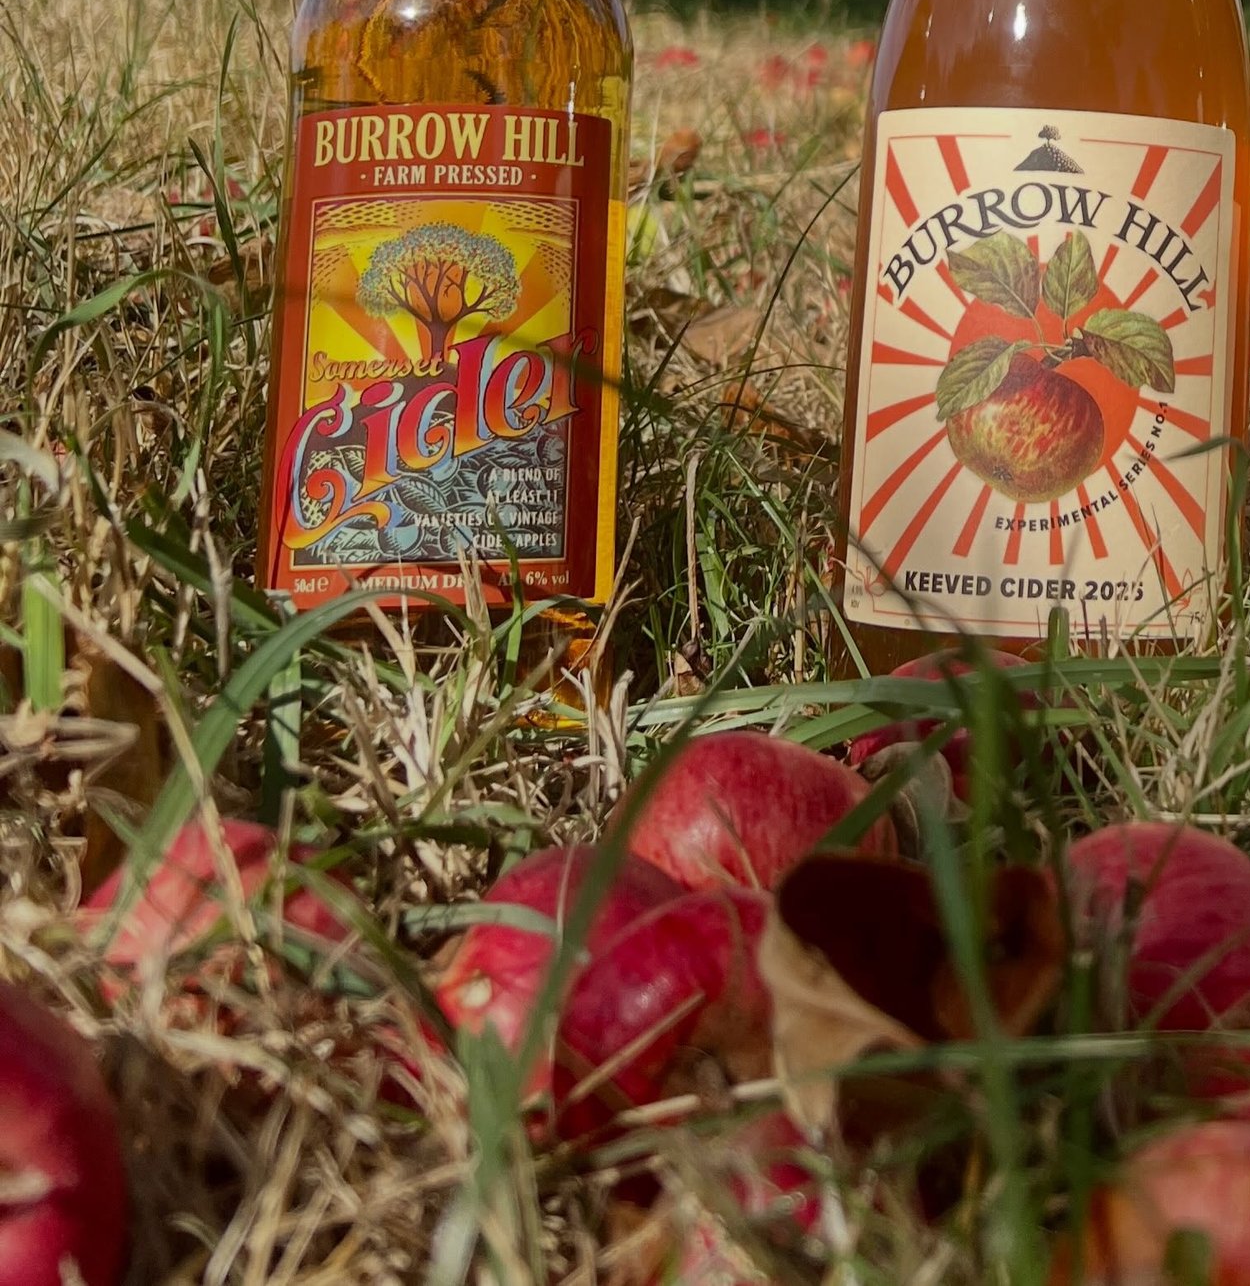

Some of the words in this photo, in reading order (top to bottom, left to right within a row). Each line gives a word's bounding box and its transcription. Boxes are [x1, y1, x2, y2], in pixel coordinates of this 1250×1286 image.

[313, 112, 493, 169] BURROW
[502, 114, 585, 168] HILL
[372, 165, 427, 187] FARM
[433, 165, 524, 186] PRESSED
[883, 181, 1113, 300] BURROW
[1113, 200, 1210, 313] HILL
[308, 349, 446, 383] Somerset
[274, 327, 600, 551] Cider
[488, 468, 498, 482] A
[503, 467, 543, 482] BLEND
[545, 467, 561, 482] OF
[994, 490, 1119, 532] EXPERIMENTAL
[1118, 440, 1156, 492] SERIES
[505, 488, 542, 504] LEAST
[510, 511, 558, 526] VINTAGE
[472, 533, 511, 549] CIDE
[515, 532, 557, 548] APPLES
[524, 570, 549, 586] 6%
[551, 569, 570, 586] vol
[904, 569, 993, 597] KEEVED
[1000, 576, 1076, 601] CIDER
